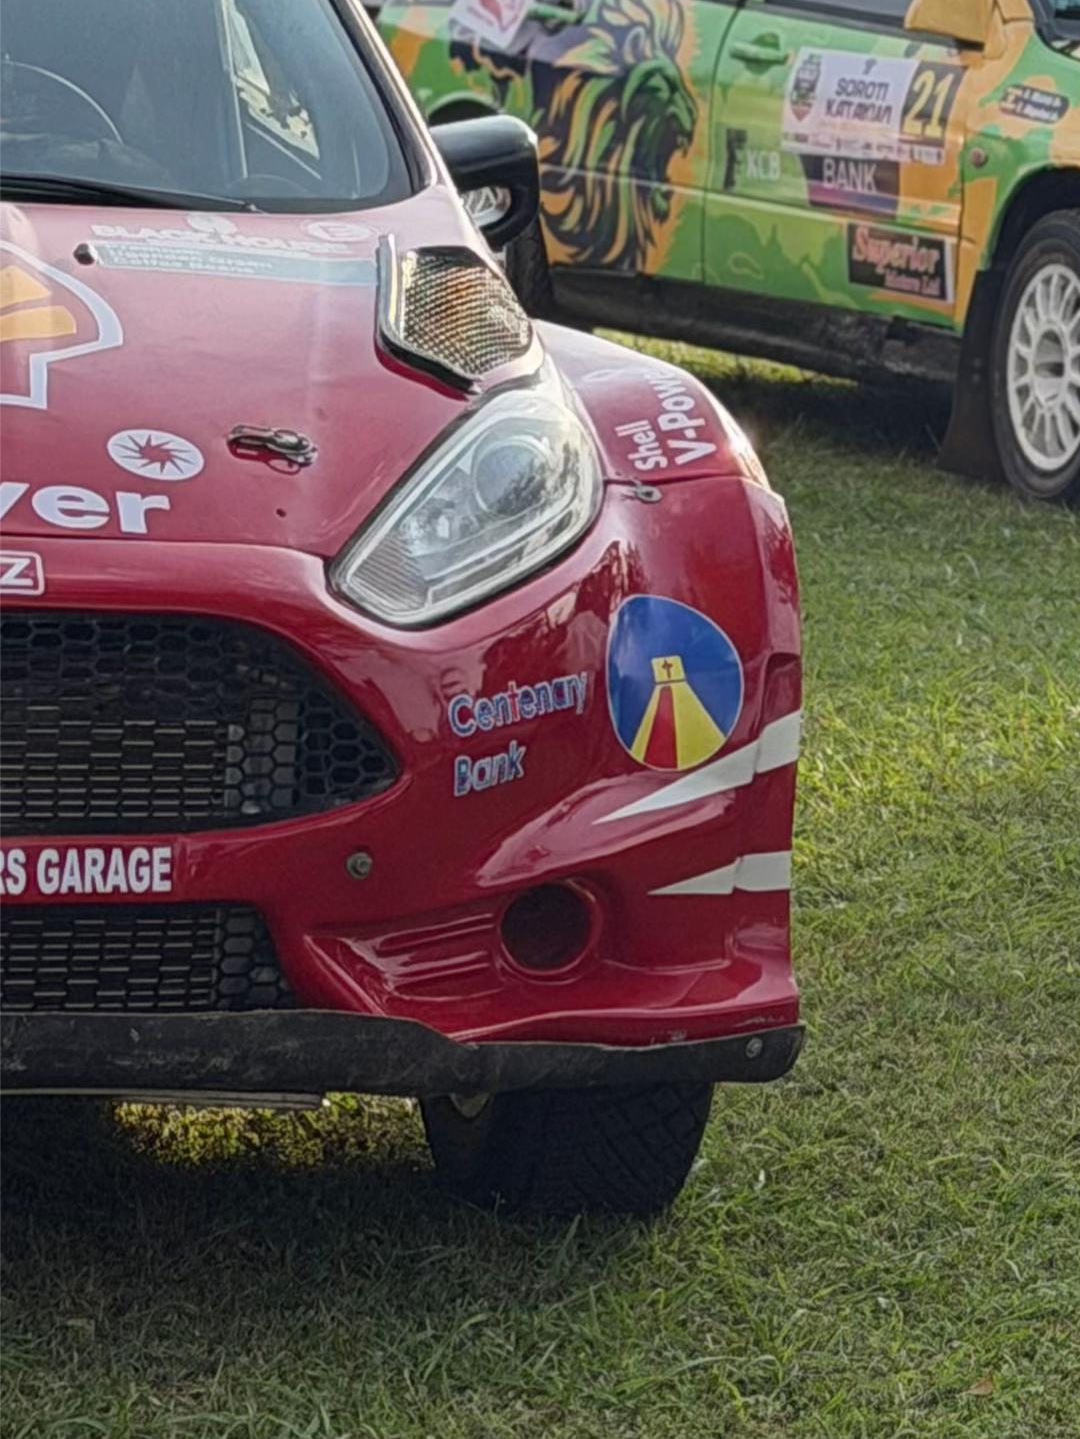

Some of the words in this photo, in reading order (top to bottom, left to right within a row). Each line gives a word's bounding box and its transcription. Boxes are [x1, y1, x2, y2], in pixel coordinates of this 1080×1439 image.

[835, 78, 890, 101] SOROTI
[903, 70, 954, 138] 21
[823, 158, 878, 193] BANK
[852, 225, 940, 275] Superior
[614, 419, 669, 471] Shell
[448, 671, 588, 737] Centenary
[454, 739, 527, 797] Bank
[37, 846, 172, 895] GARAGE
